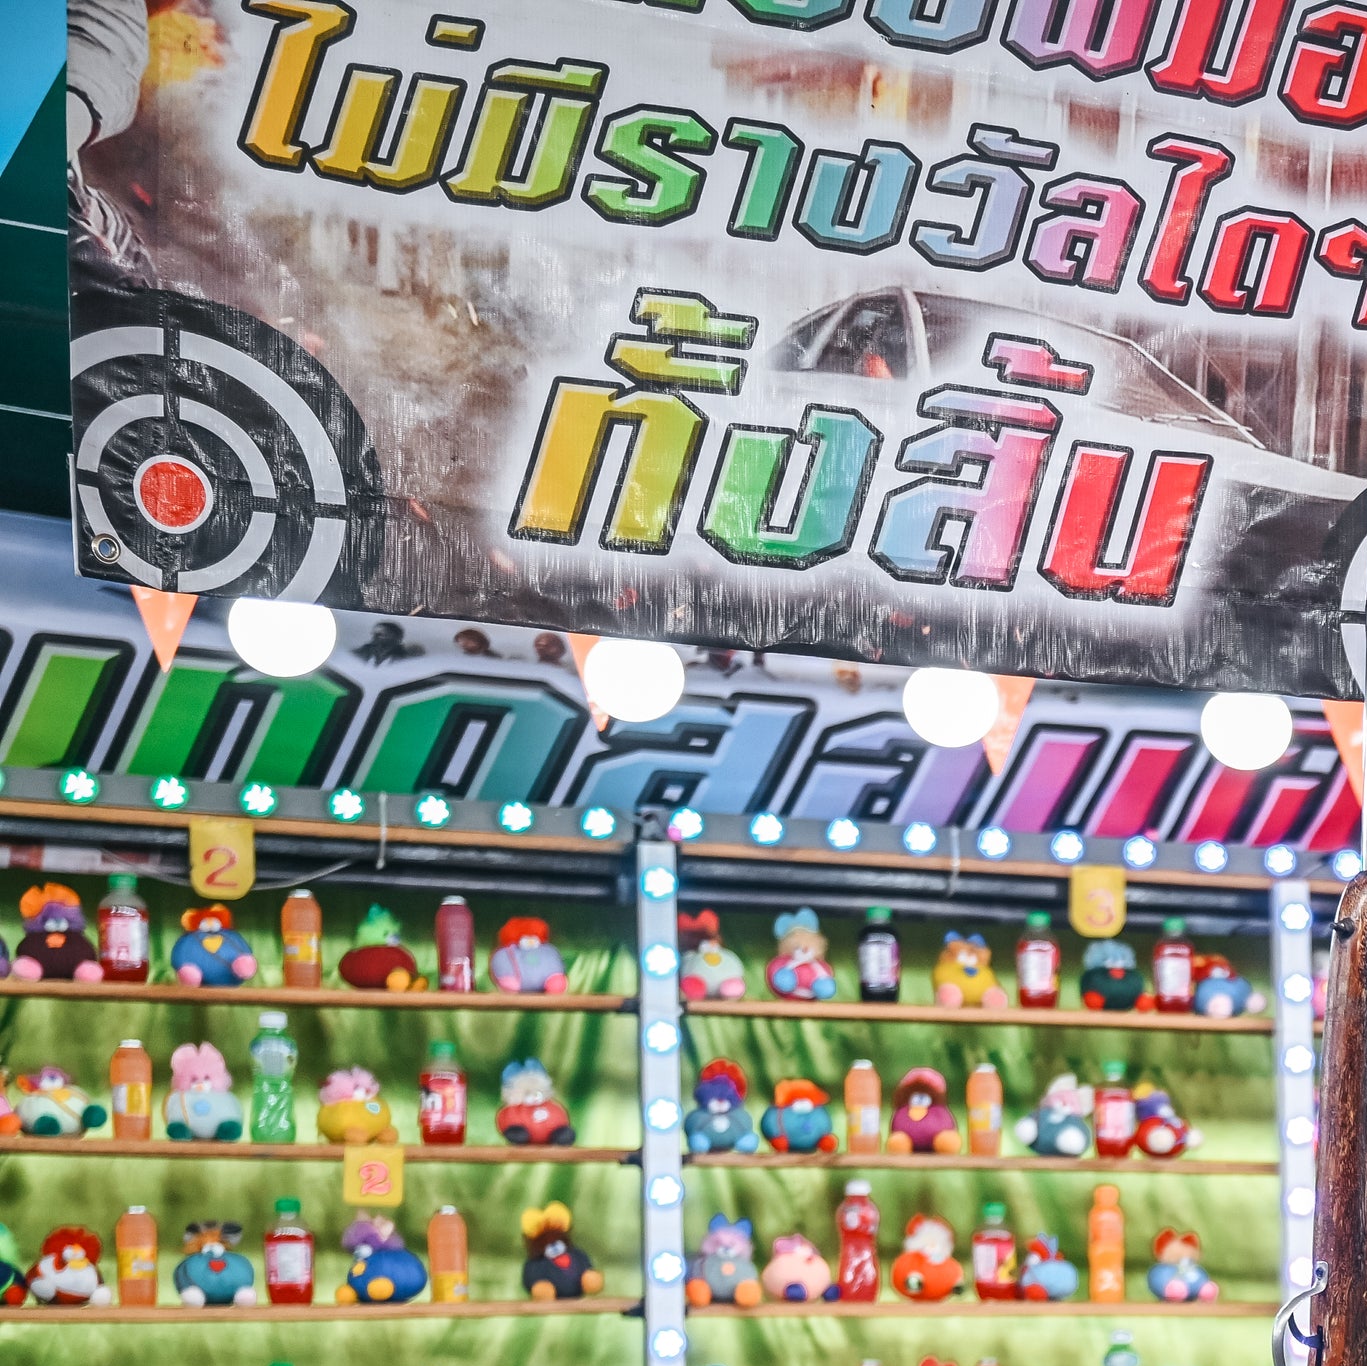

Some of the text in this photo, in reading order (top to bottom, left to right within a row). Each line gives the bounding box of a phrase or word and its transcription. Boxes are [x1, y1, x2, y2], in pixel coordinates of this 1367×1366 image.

[508, 286, 1215, 608] ทั้งสิ้น
[201, 846, 240, 889] 2
